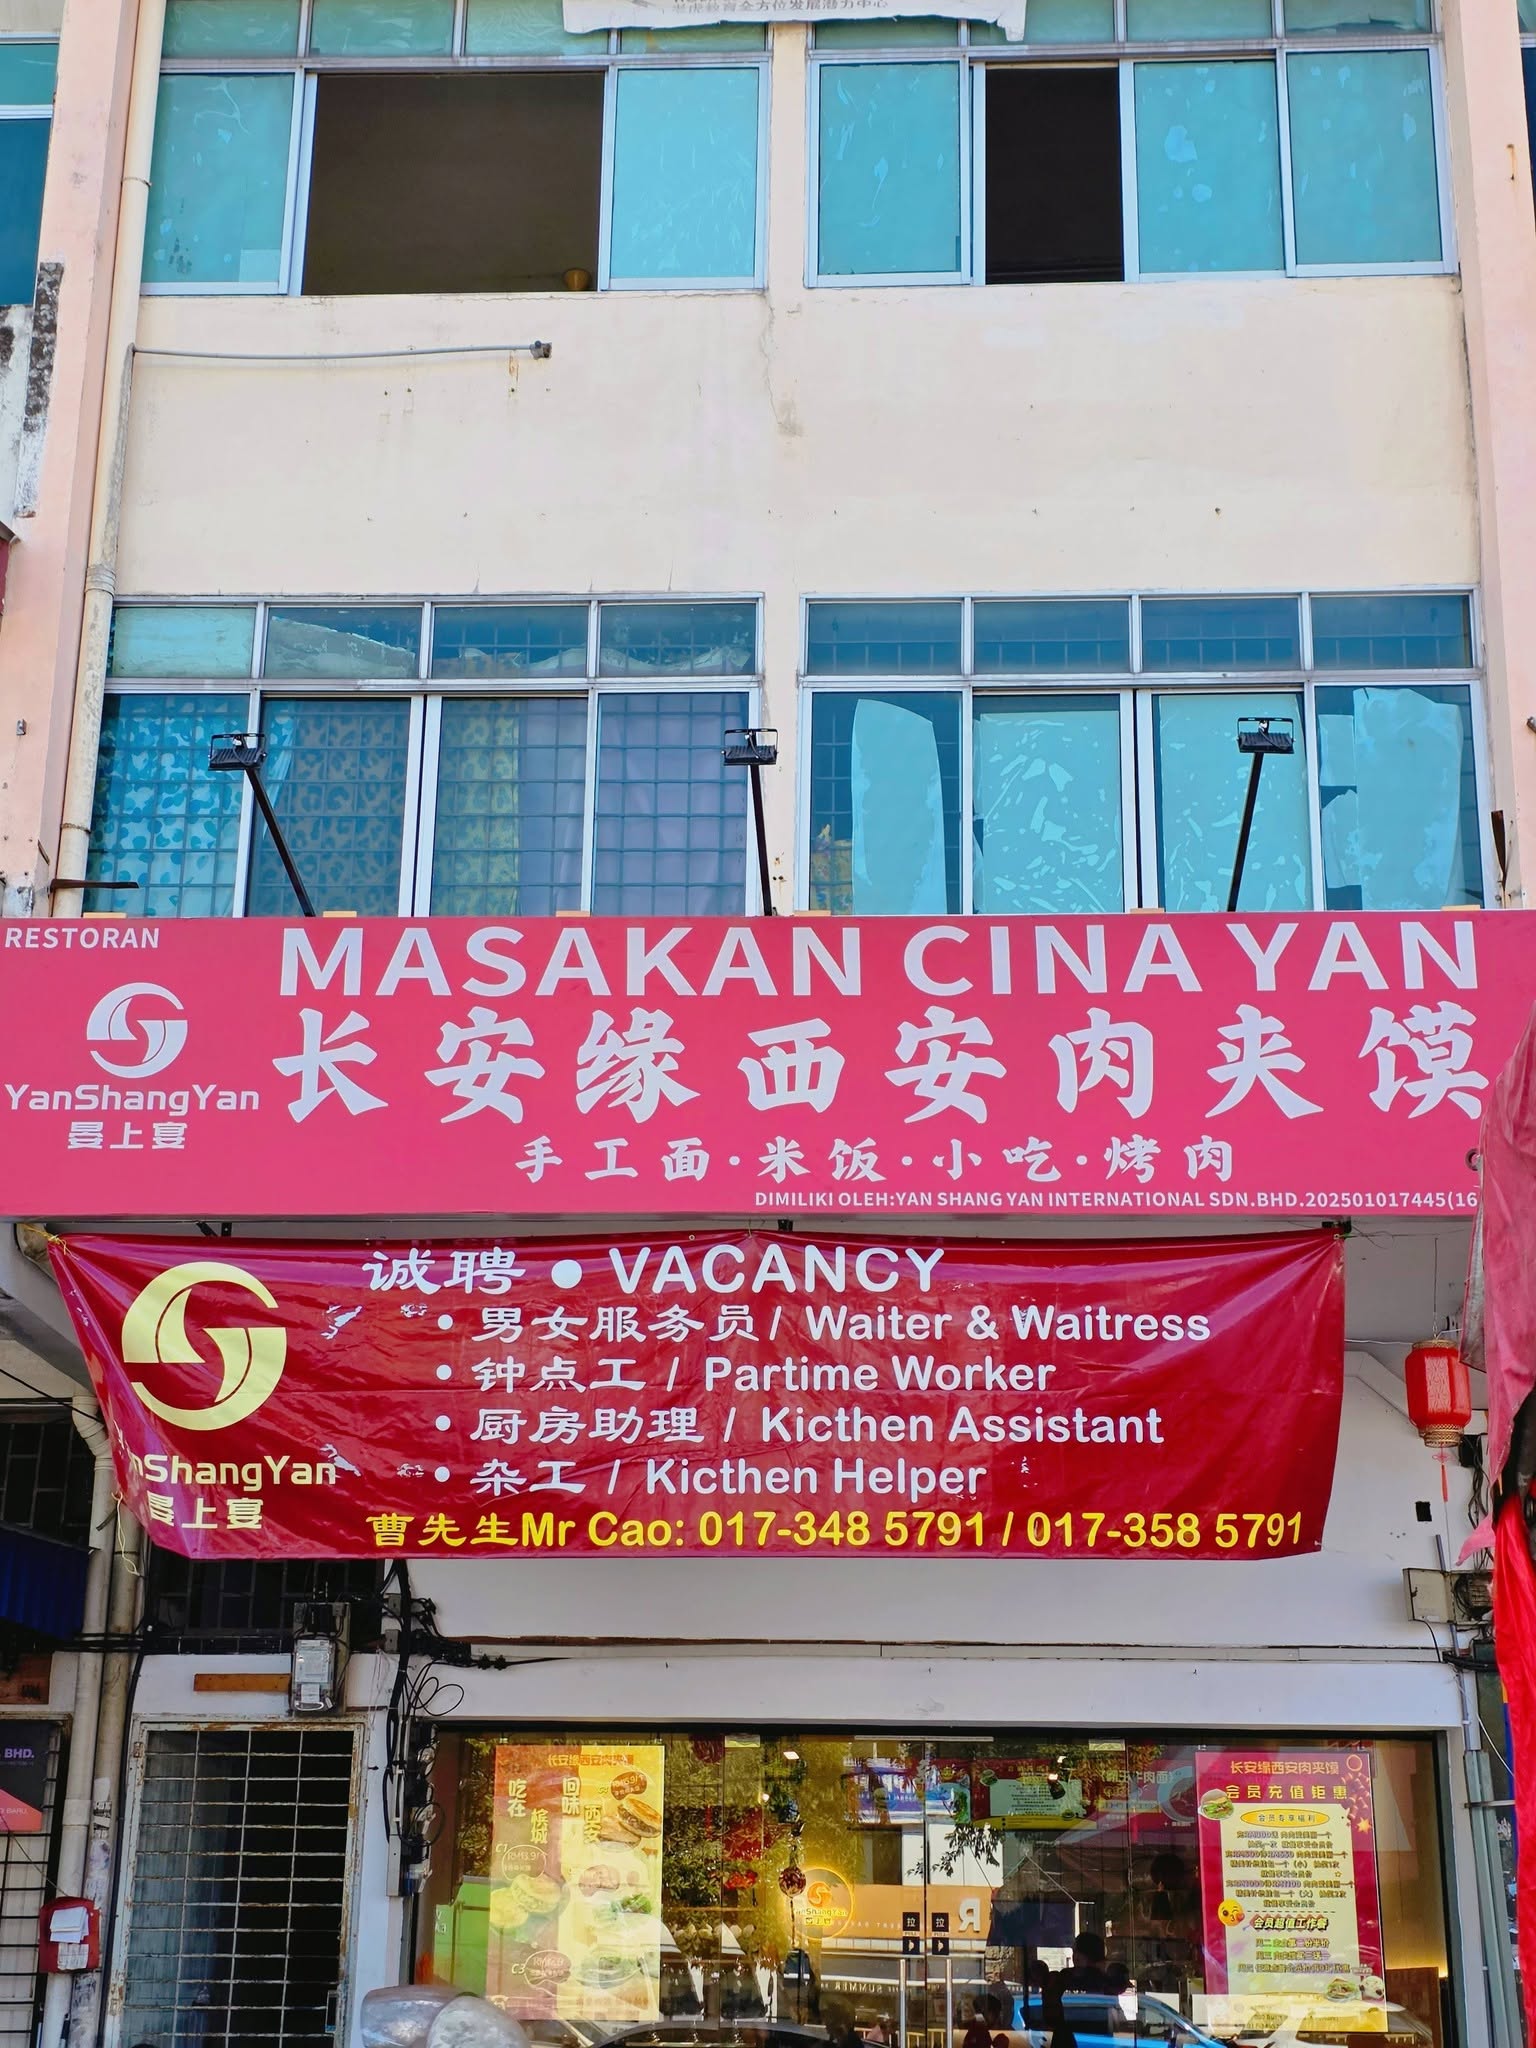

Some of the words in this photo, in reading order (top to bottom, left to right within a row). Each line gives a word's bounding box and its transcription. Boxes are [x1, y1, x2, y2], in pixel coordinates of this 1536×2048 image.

[4, 927, 160, 949] RESTORAN
[279, 926, 862, 997] MASAKAN
[903, 923, 1203, 996] CINA
[1227, 920, 1478, 992] YAN
[272, 1001, 1490, 1124] 长安缘西安肉夹馍
[4, 1083, 260, 1115] YanShangYan
[754, 1191, 834, 1208] DIMILIKI
[838, 1191, 933, 1208] OLEH:YAN
[937, 1191, 1004, 1208] SHANG
[1006, 1191, 1043, 1208] YAN
[1048, 1191, 1204, 1208] INTERNATIONAL
[361, 1246, 526, 1296] 诚聘
[608, 1245, 945, 1295] VACANCY
[805, 1305, 953, 1342] Waiter
[966, 1306, 999, 1341] &
[1012, 1304, 1211, 1342] Waitress
[470, 1357, 646, 1394] 钟点工
[667, 1357, 679, 1391] /
[705, 1356, 878, 1392] Partime
[890, 1356, 1057, 1392] Worker
[470, 1407, 705, 1446] 厨房助理
[724, 1408, 736, 1441] /
[761, 1405, 934, 1443] Kicthen
[948, 1406, 1164, 1444] Assistant
[469, 1458, 585, 1495] 杂工
[608, 1461, 620, 1494] /
[647, 1458, 818, 1495] Kicthen
[834, 1458, 987, 1503] Helper
[588, 1511, 684, 1547] Cao:
[699, 1511, 871, 1548] 017-348
[884, 1511, 985, 1547] 5791
[1001, 1511, 1012, 1547] /
[1027, 1511, 1200, 1549] 017-358
[1214, 1511, 1302, 1549] 5791
[4, 1748, 35, 1759] BHD.
[1230, 1760, 1340, 1775] 长安缘西安肉夹馍
[1225, 1784, 1348, 1800] 会员充值钜惠
